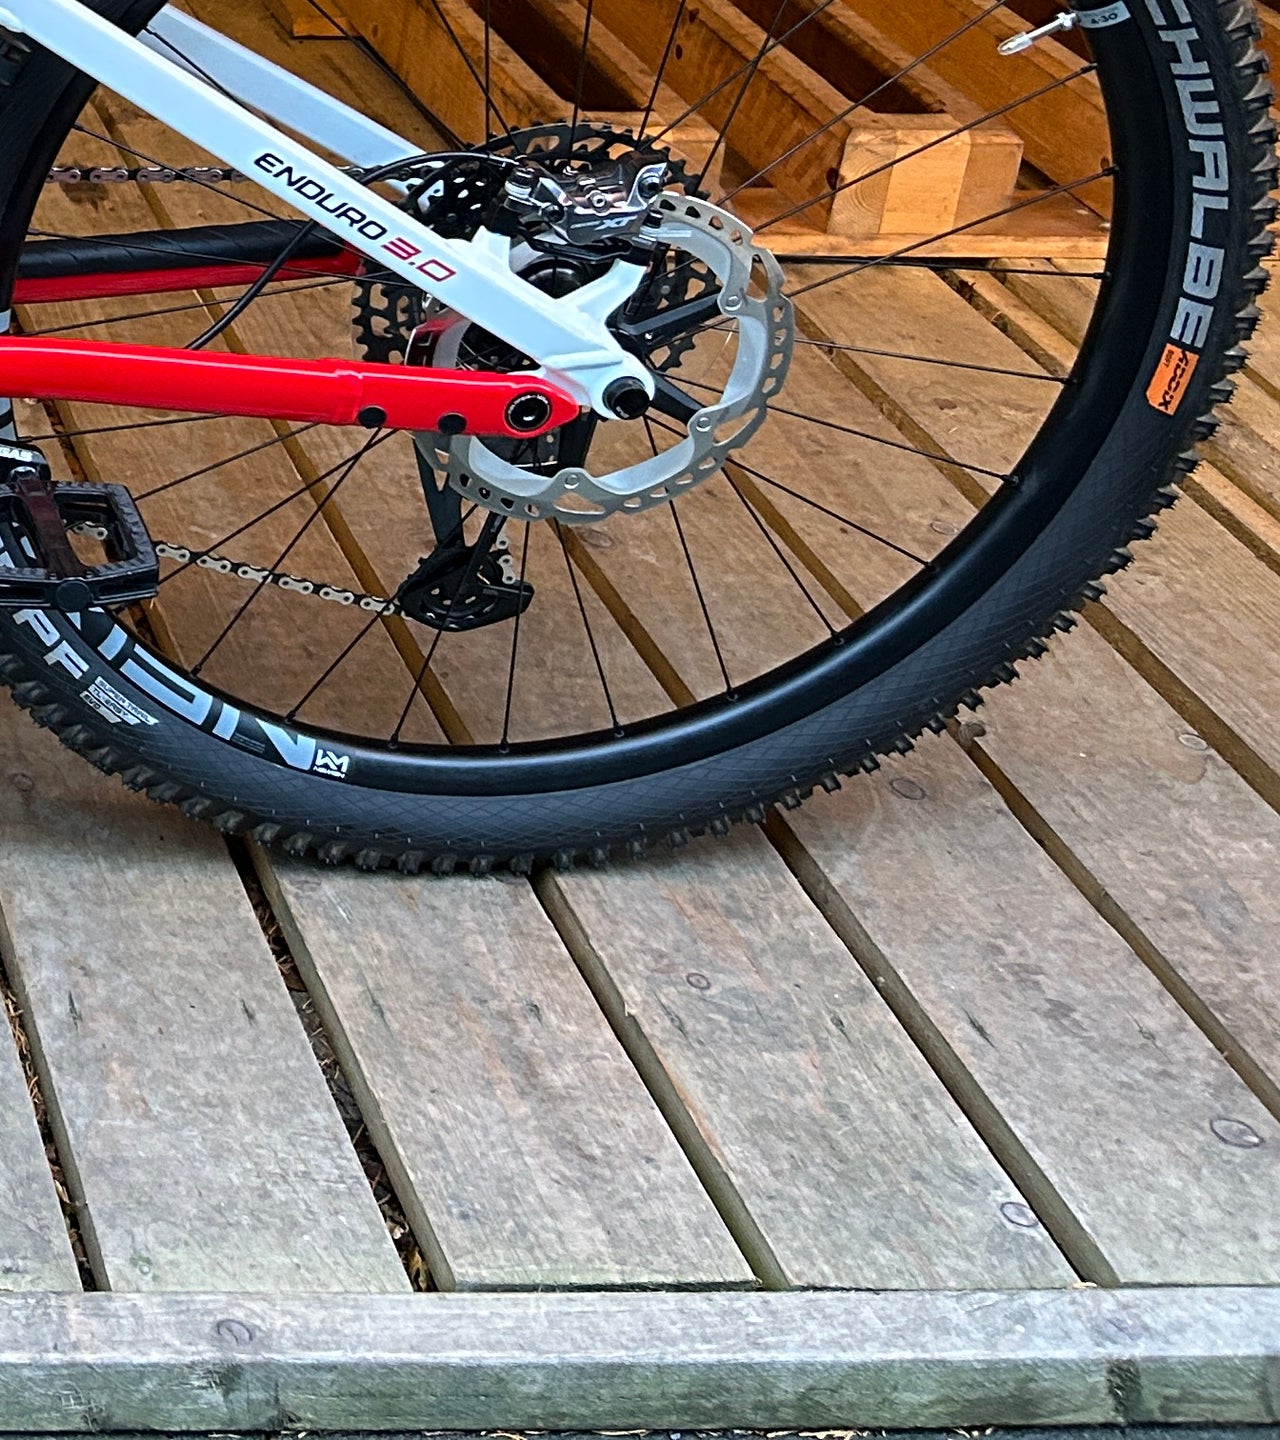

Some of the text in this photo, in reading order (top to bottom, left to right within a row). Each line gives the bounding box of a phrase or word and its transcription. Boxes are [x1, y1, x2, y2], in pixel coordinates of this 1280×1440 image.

[253, 152, 457, 282] ENDURO 3.0
[593, 215, 637, 231] XT
[82, 693, 102, 711] EVO
[98, 679, 152, 722] SUPER TRAIL
